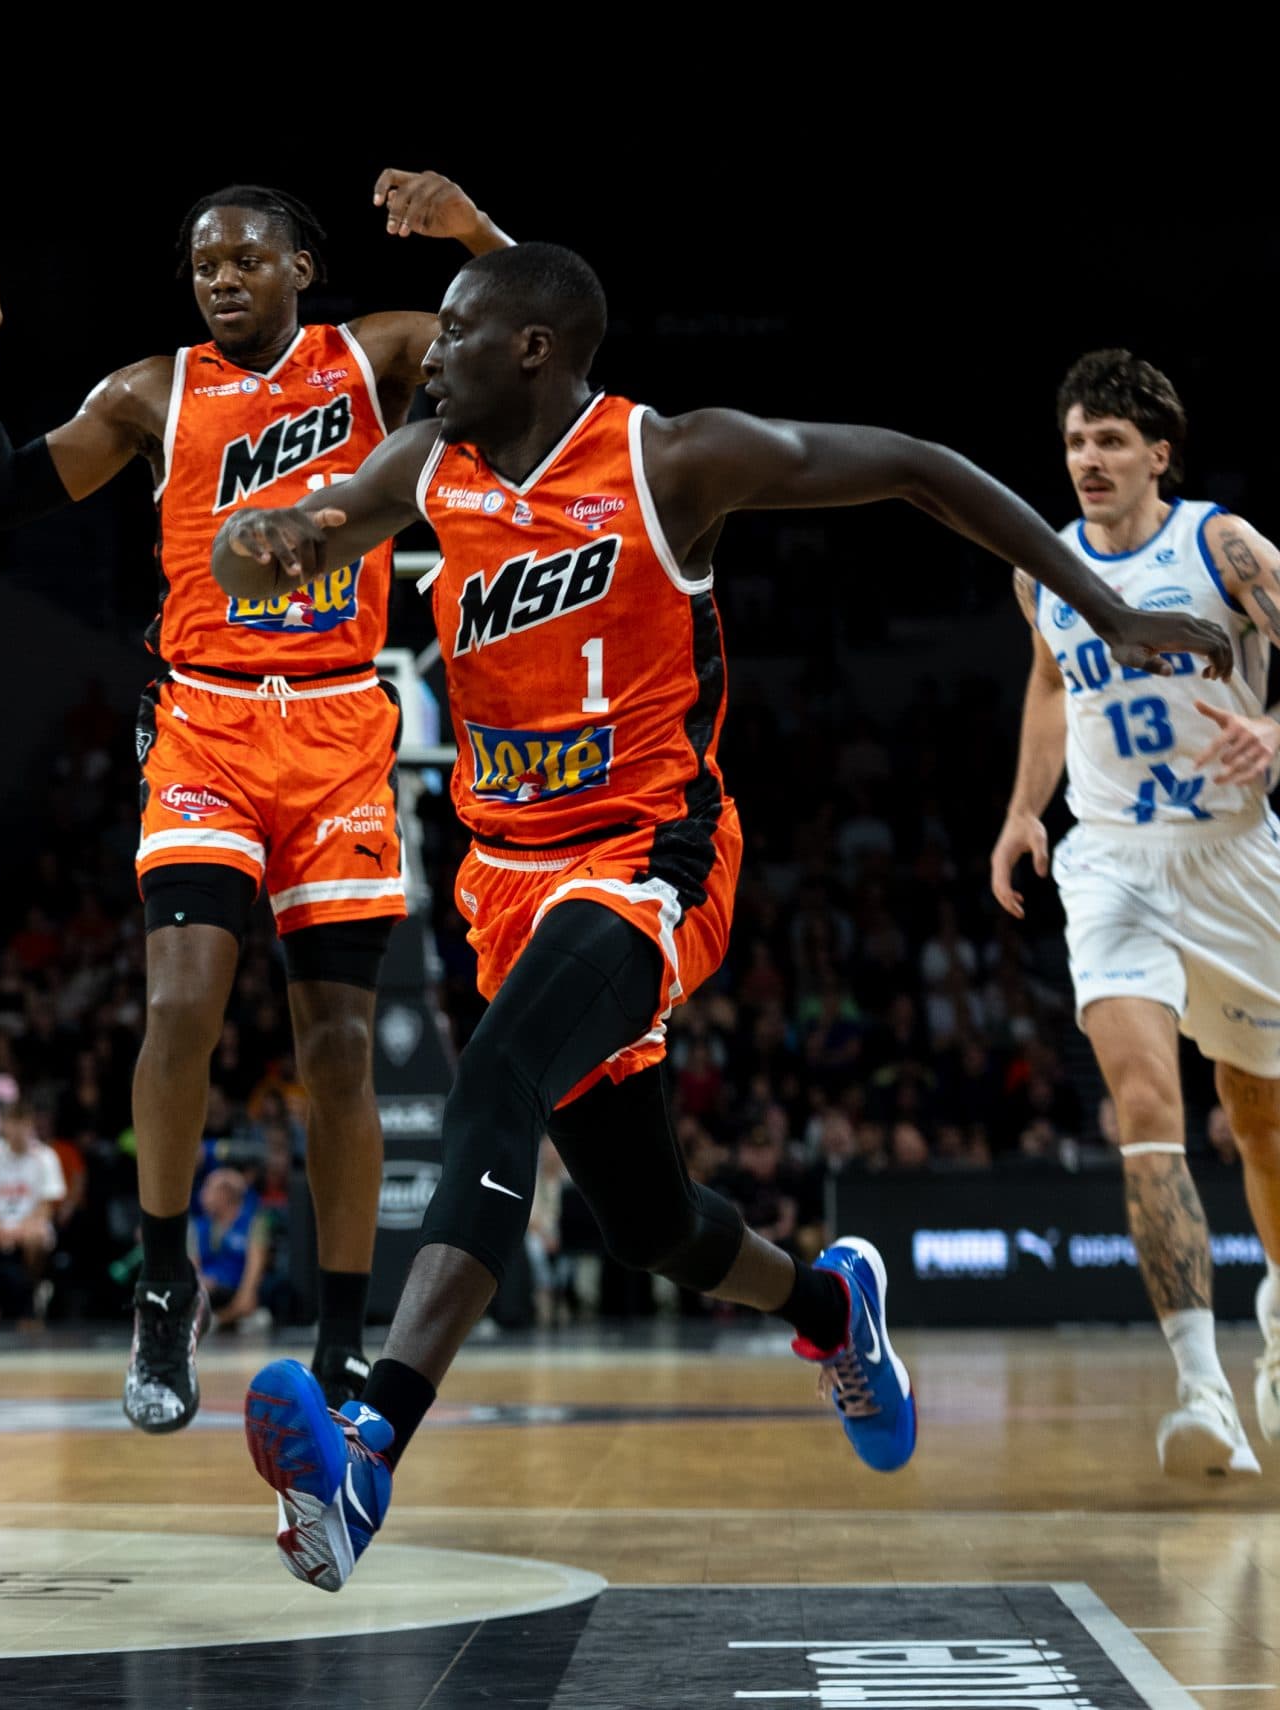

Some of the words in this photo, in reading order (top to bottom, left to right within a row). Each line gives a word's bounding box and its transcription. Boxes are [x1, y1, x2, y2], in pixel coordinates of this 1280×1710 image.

[212, 393, 353, 516] MSB
[572, 497, 625, 520] Gaulois
[453, 533, 622, 658] MSB
[581, 637, 609, 712] 1
[1104, 695, 1175, 758] 13
[343, 817, 384, 836] Rapin
